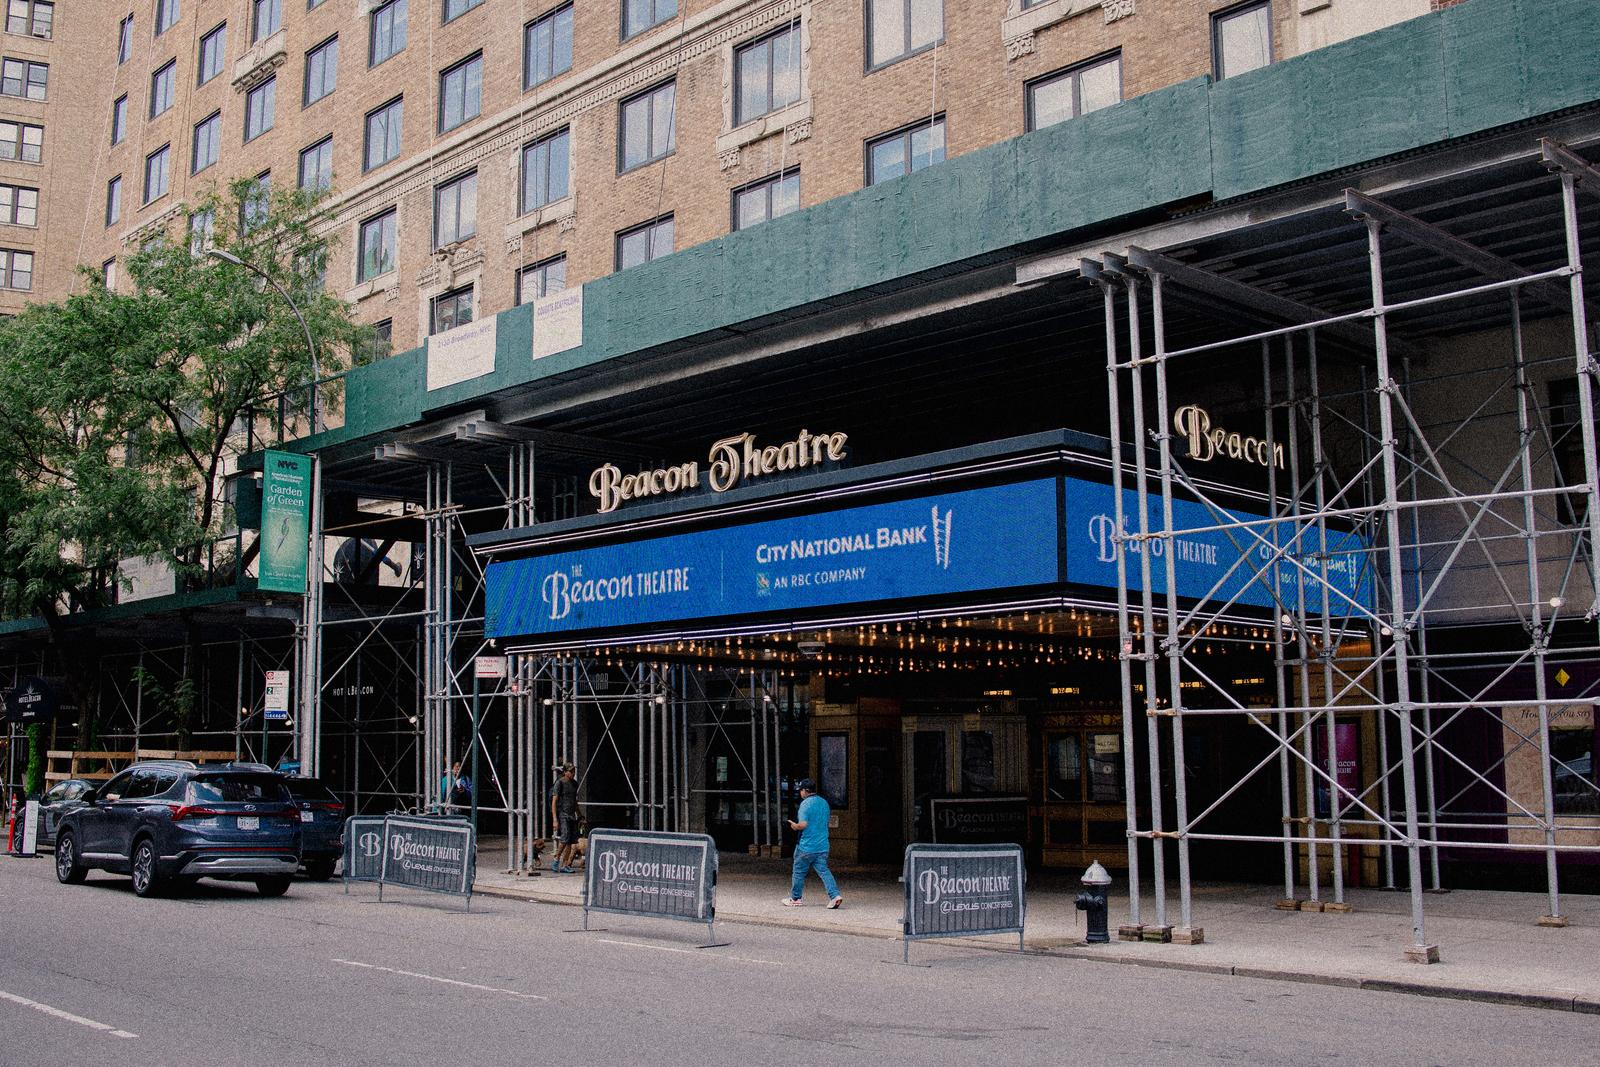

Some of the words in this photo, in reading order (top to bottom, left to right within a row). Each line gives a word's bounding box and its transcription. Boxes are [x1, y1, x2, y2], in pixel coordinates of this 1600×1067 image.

[479, 324, 491, 334] NYC
[1174, 404, 1284, 470] Beacon
[277, 459, 299, 470] NYC
[589, 462, 700, 514] Beacon
[708, 428, 848, 493] Theatre
[270, 484, 302, 497] Garden
[267, 494, 278, 505] of
[277, 494, 304, 506] Green
[756, 543, 788, 563] CITY
[790, 532, 874, 560] NATIONAL
[876, 524, 928, 548] BANK
[1176, 539, 1218, 566] THEATRE
[571, 564, 583, 577] THE
[774, 576, 788, 589] AN
[791, 573, 812, 587] RBC
[814, 566, 866, 585] COMPANY
[541, 570, 634, 620] Beacon
[636, 566, 690, 596] THEATRE
[332, 687, 351, 697] HOTL
[390, 833, 435, 861] Beacon
[435, 846, 461, 861] THEATRE
[411, 863, 433, 872] LEXUS
[598, 850, 660, 882] Beacon
[661, 862, 695, 881] THEATRE
[628, 885, 659, 895] LEXUS
[919, 867, 981, 905] Beacon
[981, 875, 1011, 893] THEATRE
[951, 901, 980, 912] LEXUS
